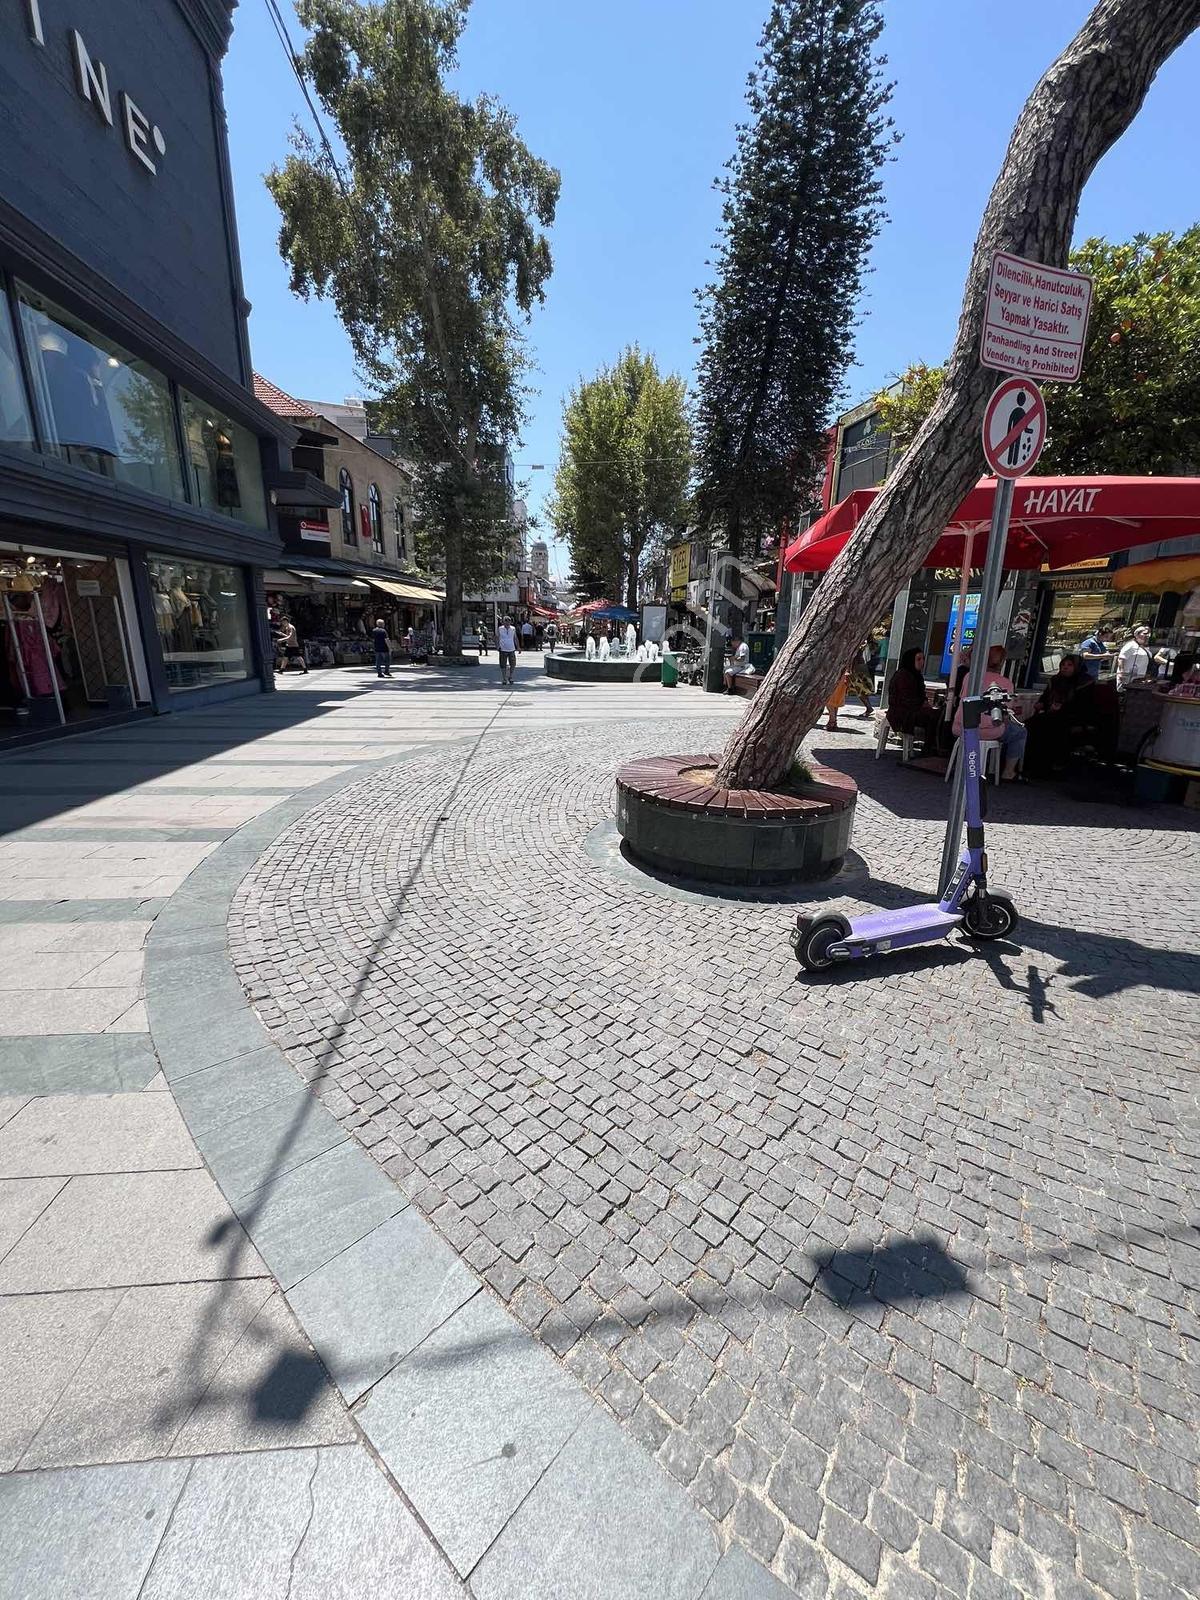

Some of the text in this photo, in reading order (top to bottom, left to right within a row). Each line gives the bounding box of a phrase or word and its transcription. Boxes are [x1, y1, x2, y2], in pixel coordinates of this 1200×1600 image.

[994, 283, 1082, 320] Seyyar ve Harici Satış
[1001, 307, 1030, 327] Yapmak
[987, 331, 1077, 359] Panhandling And Street
[987, 347, 1074, 374] Vendors Are Prohibited
[1024, 488, 1102, 514] HAYAT
